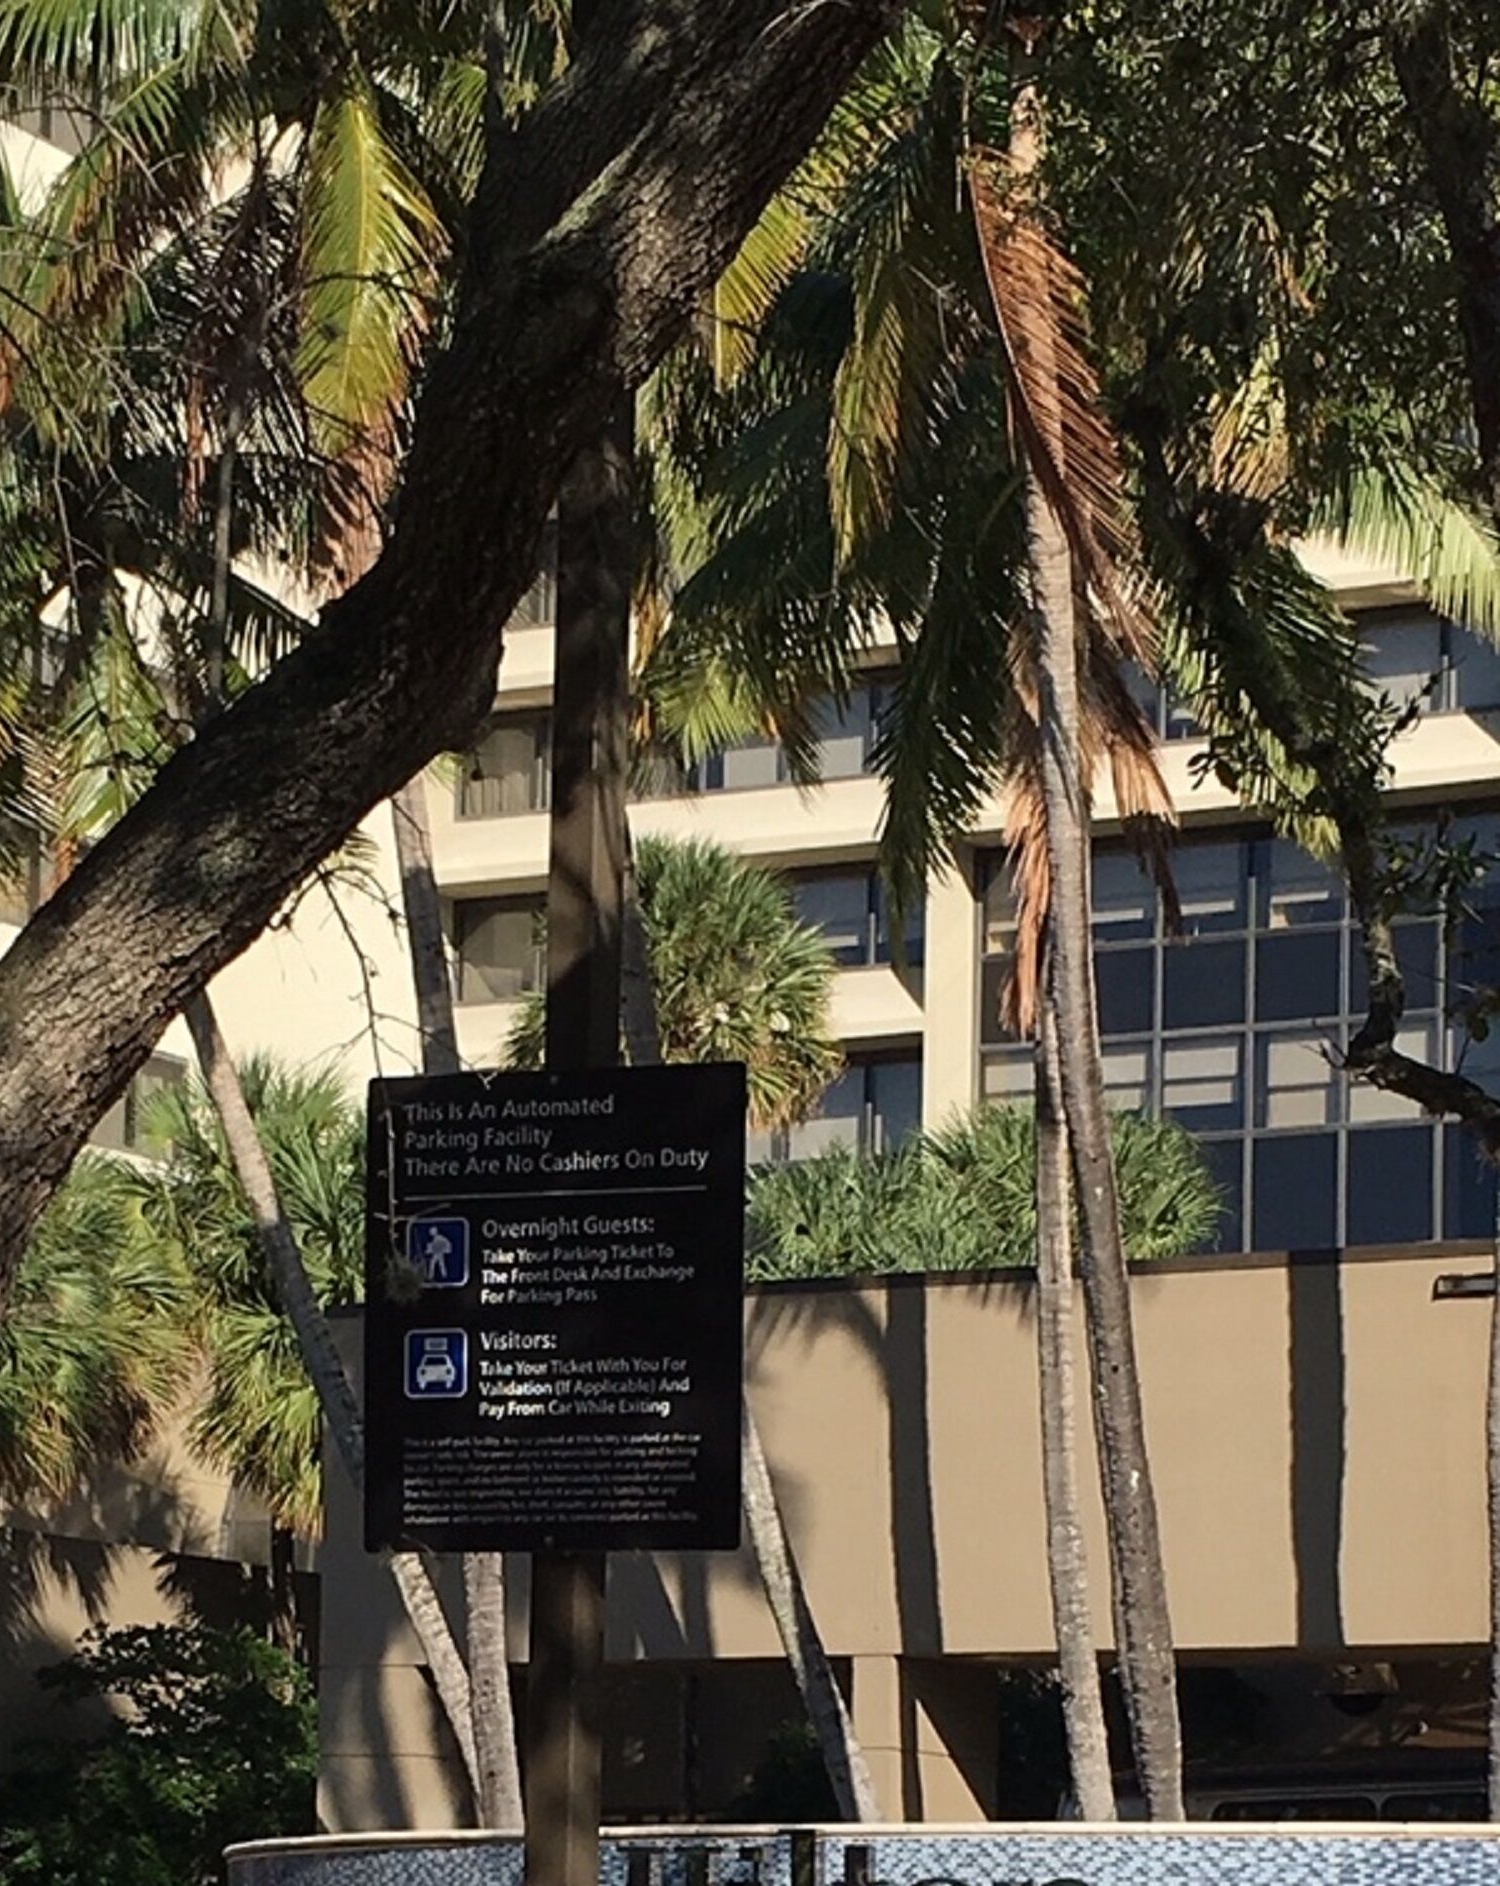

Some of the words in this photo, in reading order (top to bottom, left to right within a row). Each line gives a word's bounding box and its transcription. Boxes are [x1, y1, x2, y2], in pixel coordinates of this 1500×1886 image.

[404, 1102, 444, 1121] This
[449, 1102, 464, 1120] Is
[468, 1101, 497, 1119] An
[502, 1093, 615, 1117] Automated
[404, 1129, 479, 1153] Parking
[484, 1123, 553, 1148] Facility
[404, 1157, 460, 1176] There
[464, 1156, 500, 1174] Are
[506, 1154, 534, 1173] No
[539, 1149, 620, 1172] Cashiers
[624, 1149, 654, 1169] On
[660, 1147, 709, 1171] Duty
[482, 1216, 578, 1241] Overnight
[583, 1214, 655, 1235] Guests:
[482, 1247, 515, 1264] Take
[516, 1247, 549, 1263] Your
[553, 1245, 608, 1264] Parking
[611, 1244, 653, 1259] Ticket
[656, 1242, 675, 1258] To
[481, 1268, 508, 1284] The
[511, 1267, 549, 1283] Front
[553, 1265, 588, 1281] Desk
[591, 1264, 621, 1280] And
[623, 1264, 695, 1283] Exchange
[481, 1288, 505, 1305] For
[507, 1288, 563, 1306] Parking
[566, 1286, 598, 1302] Pass
[480, 1330, 558, 1351] Visitors:
[479, 1360, 513, 1376] Take
[514, 1360, 547, 1376] Your
[550, 1359, 593, 1374] Ticket
[596, 1358, 630, 1373] With
[630, 1357, 660, 1372] You
[663, 1357, 688, 1371] For
[479, 1380, 552, 1396] Validation
[658, 1376, 690, 1392] And
[479, 1401, 505, 1420] Pay
[507, 1400, 545, 1416] From
[548, 1399, 572, 1415] Car
[574, 1399, 616, 1414] While
[619, 1399, 671, 1418] Exiting
